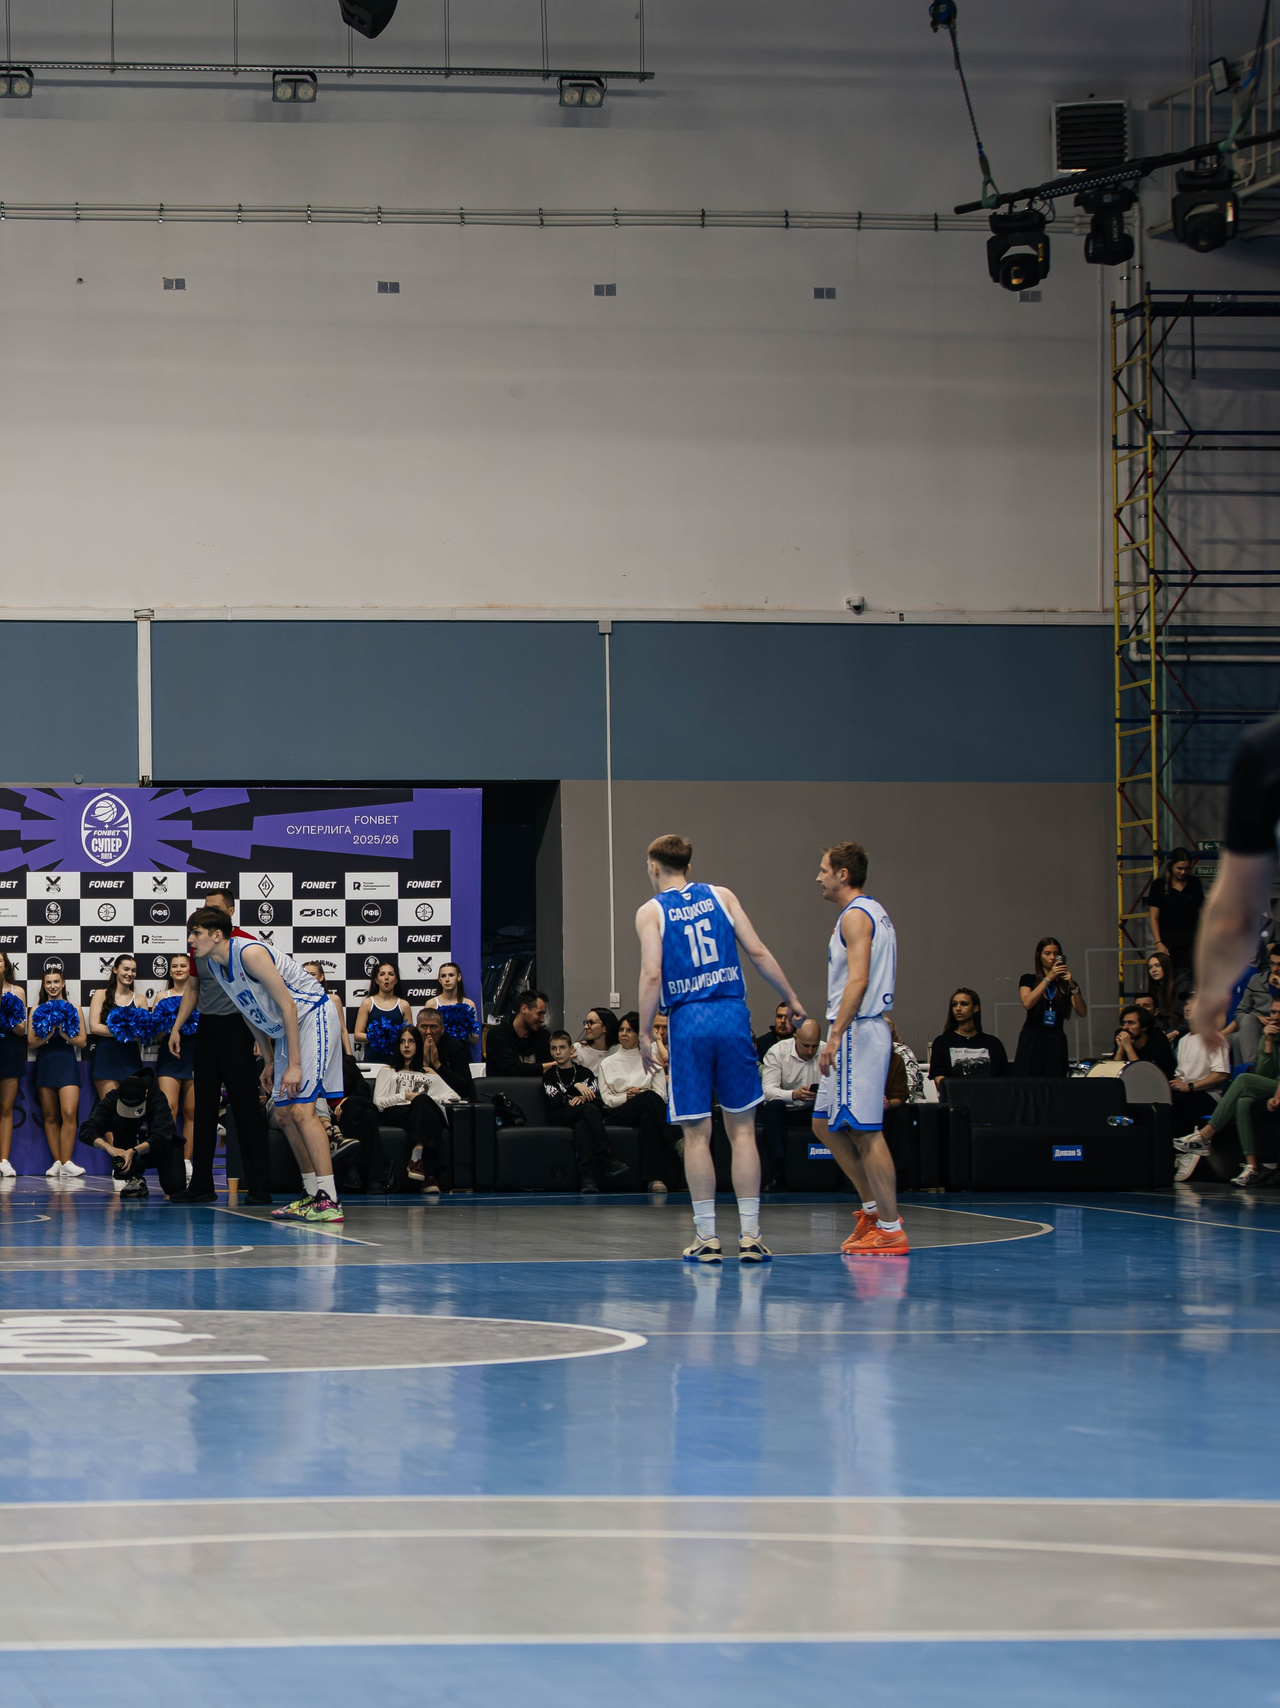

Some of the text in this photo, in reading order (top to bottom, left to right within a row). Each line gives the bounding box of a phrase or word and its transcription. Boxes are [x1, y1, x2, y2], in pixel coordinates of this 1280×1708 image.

[354, 815, 399, 825] FONBET
[286, 824, 352, 836] СУПЕРЛИГА
[353, 834, 399, 846] 2025/26
[91, 837, 123, 853] СУПЕР
[89, 880, 125, 889] FONBET
[195, 880, 231, 889] FONBET
[301, 880, 337, 889] FONBET
[407, 880, 442, 889] FONBET
[316, 908, 338, 917] ВСК
[89, 935, 125, 943] FONBET
[301, 935, 337, 944] FONBET
[367, 934, 388, 943] slavda
[407, 934, 442, 943] FONBET
[684, 918, 719, 968] 16
[668, 966, 740, 995] ВЛАДИВОСТОК
[407, 989, 437, 997] FONBE
[1076, 1149, 1082, 1157] 5
